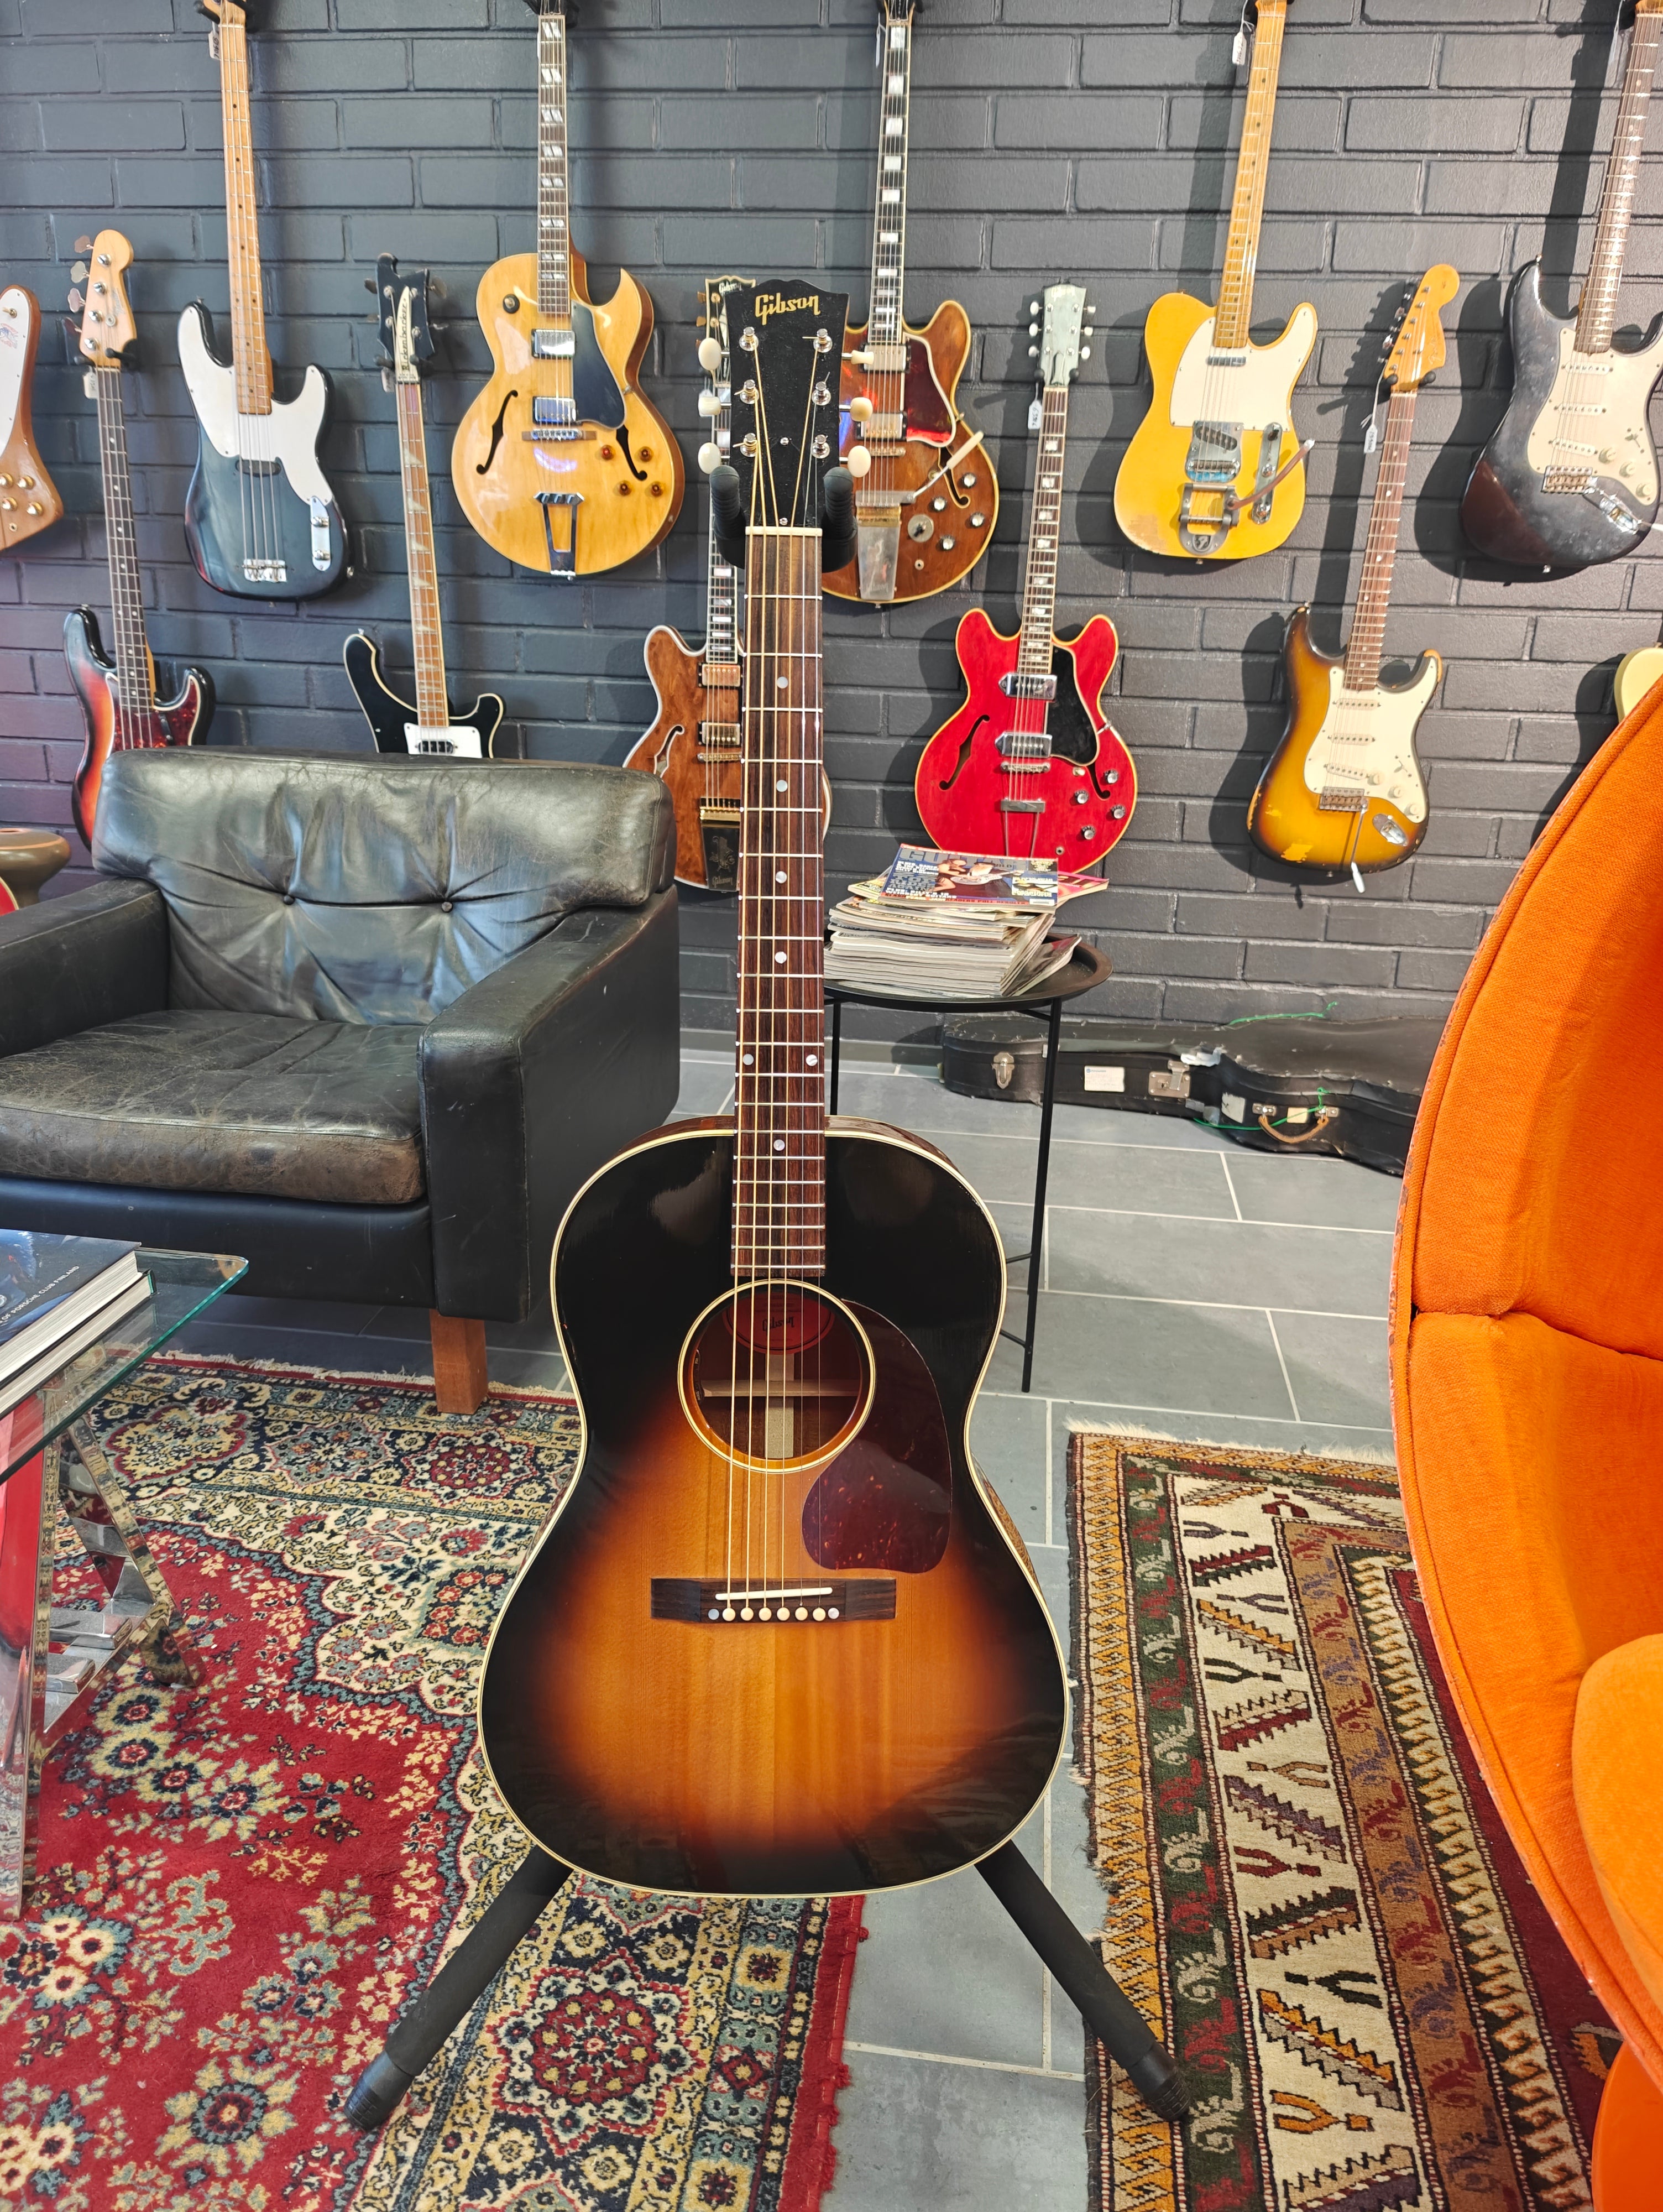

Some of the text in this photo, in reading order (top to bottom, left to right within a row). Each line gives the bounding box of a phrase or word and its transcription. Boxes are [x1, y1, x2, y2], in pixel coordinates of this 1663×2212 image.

[719, 281, 743, 295] Gibson
[755, 293, 821, 326] Gibson
[399, 302, 410, 372] Rickenbacker
[899, 848, 1027, 872] GUTAR
[712, 875, 733, 889] Gibson
[11, 1294, 40, 1314] PORSCHE
[38, 1283, 56, 1295] CLUB
[54, 1266, 80, 1284] FINLAND
